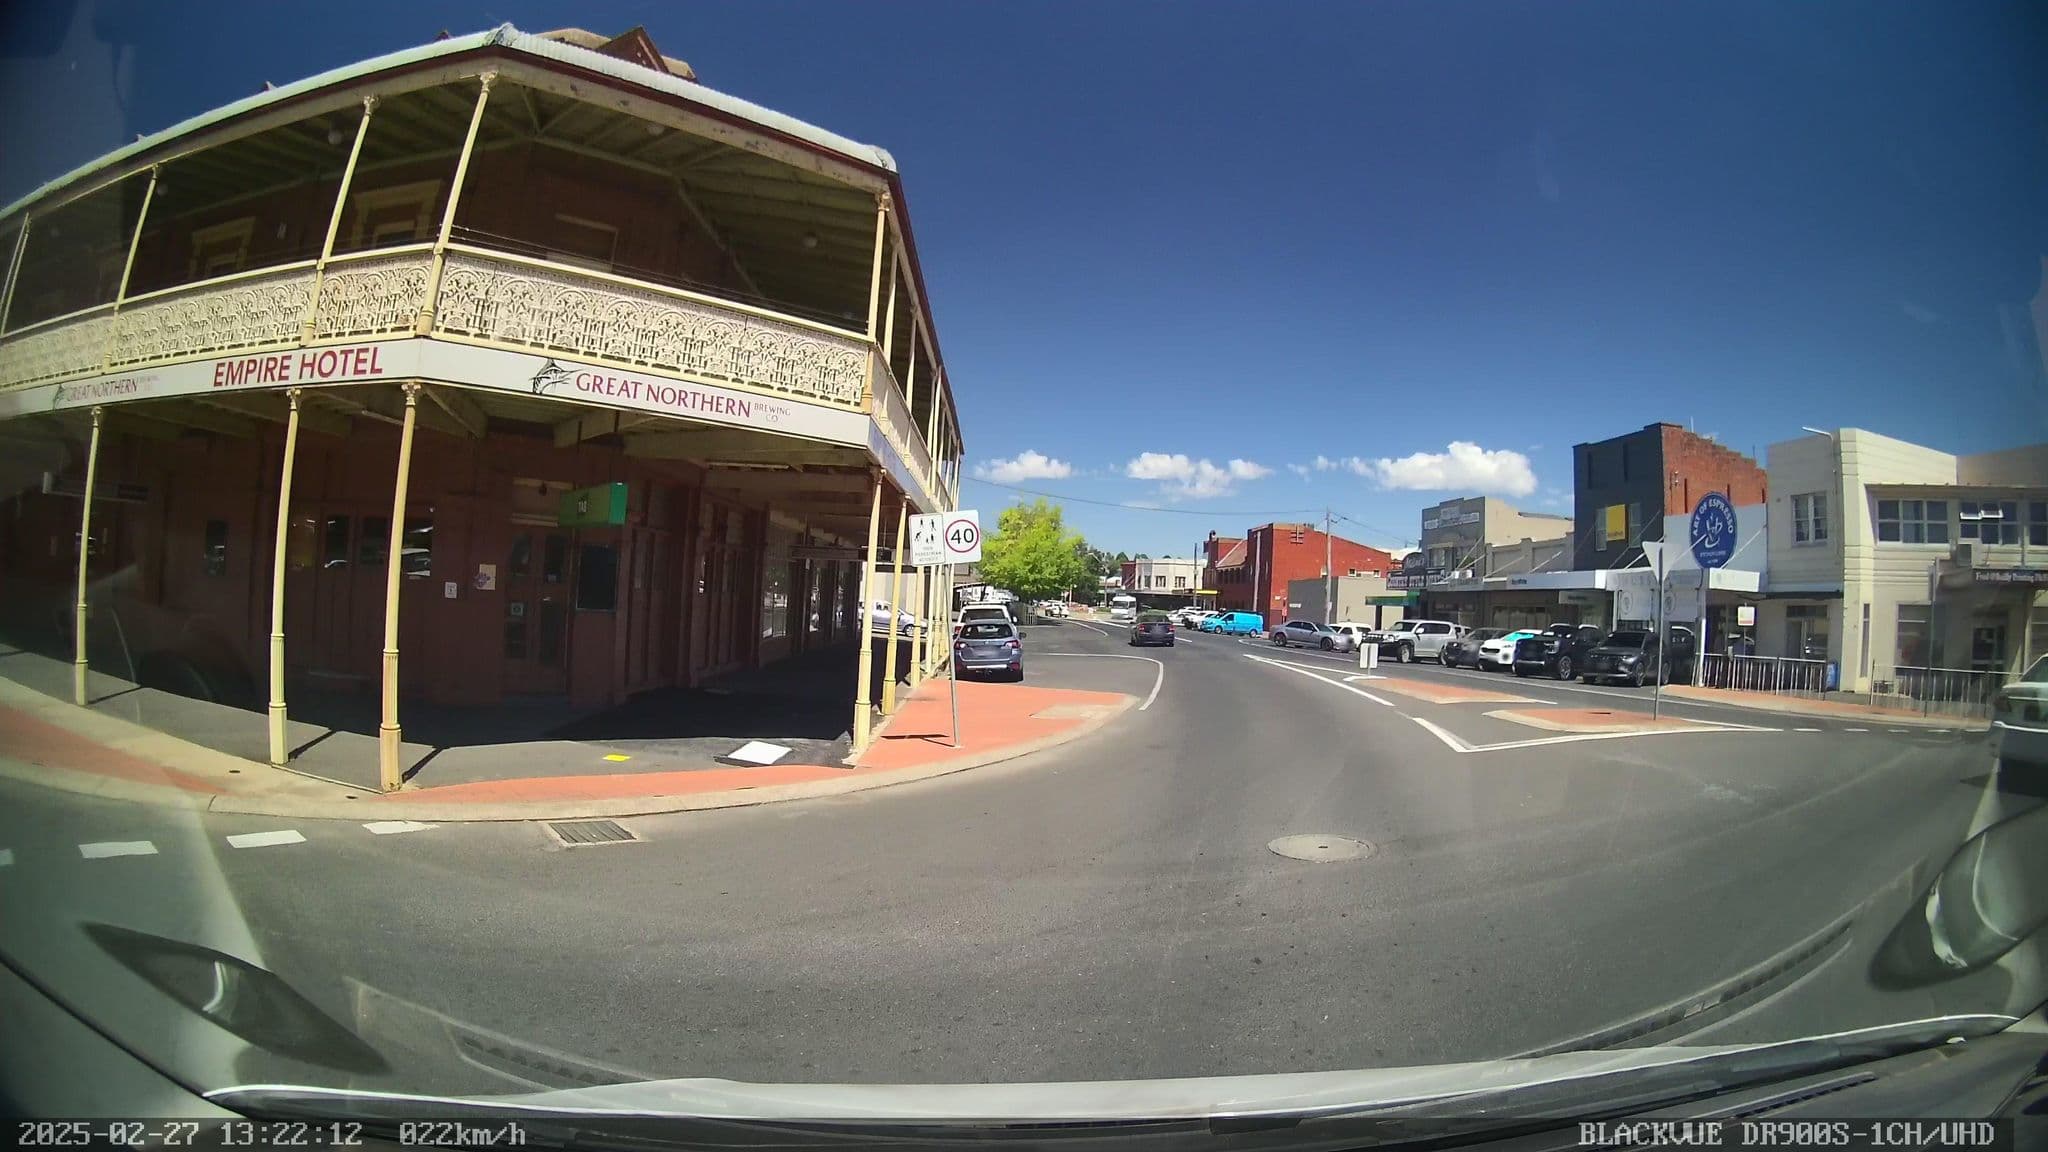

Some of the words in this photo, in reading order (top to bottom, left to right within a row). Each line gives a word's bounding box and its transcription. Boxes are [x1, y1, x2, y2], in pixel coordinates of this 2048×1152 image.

[213, 354, 292, 387] EMPIRE
[299, 347, 383, 380] HOTEL
[91, 376, 139, 398] NORTHERN
[576, 372, 642, 399] GREAT
[646, 383, 751, 418] NORTHERN
[754, 402, 791, 416] BREWING
[950, 528, 975, 545] 40
